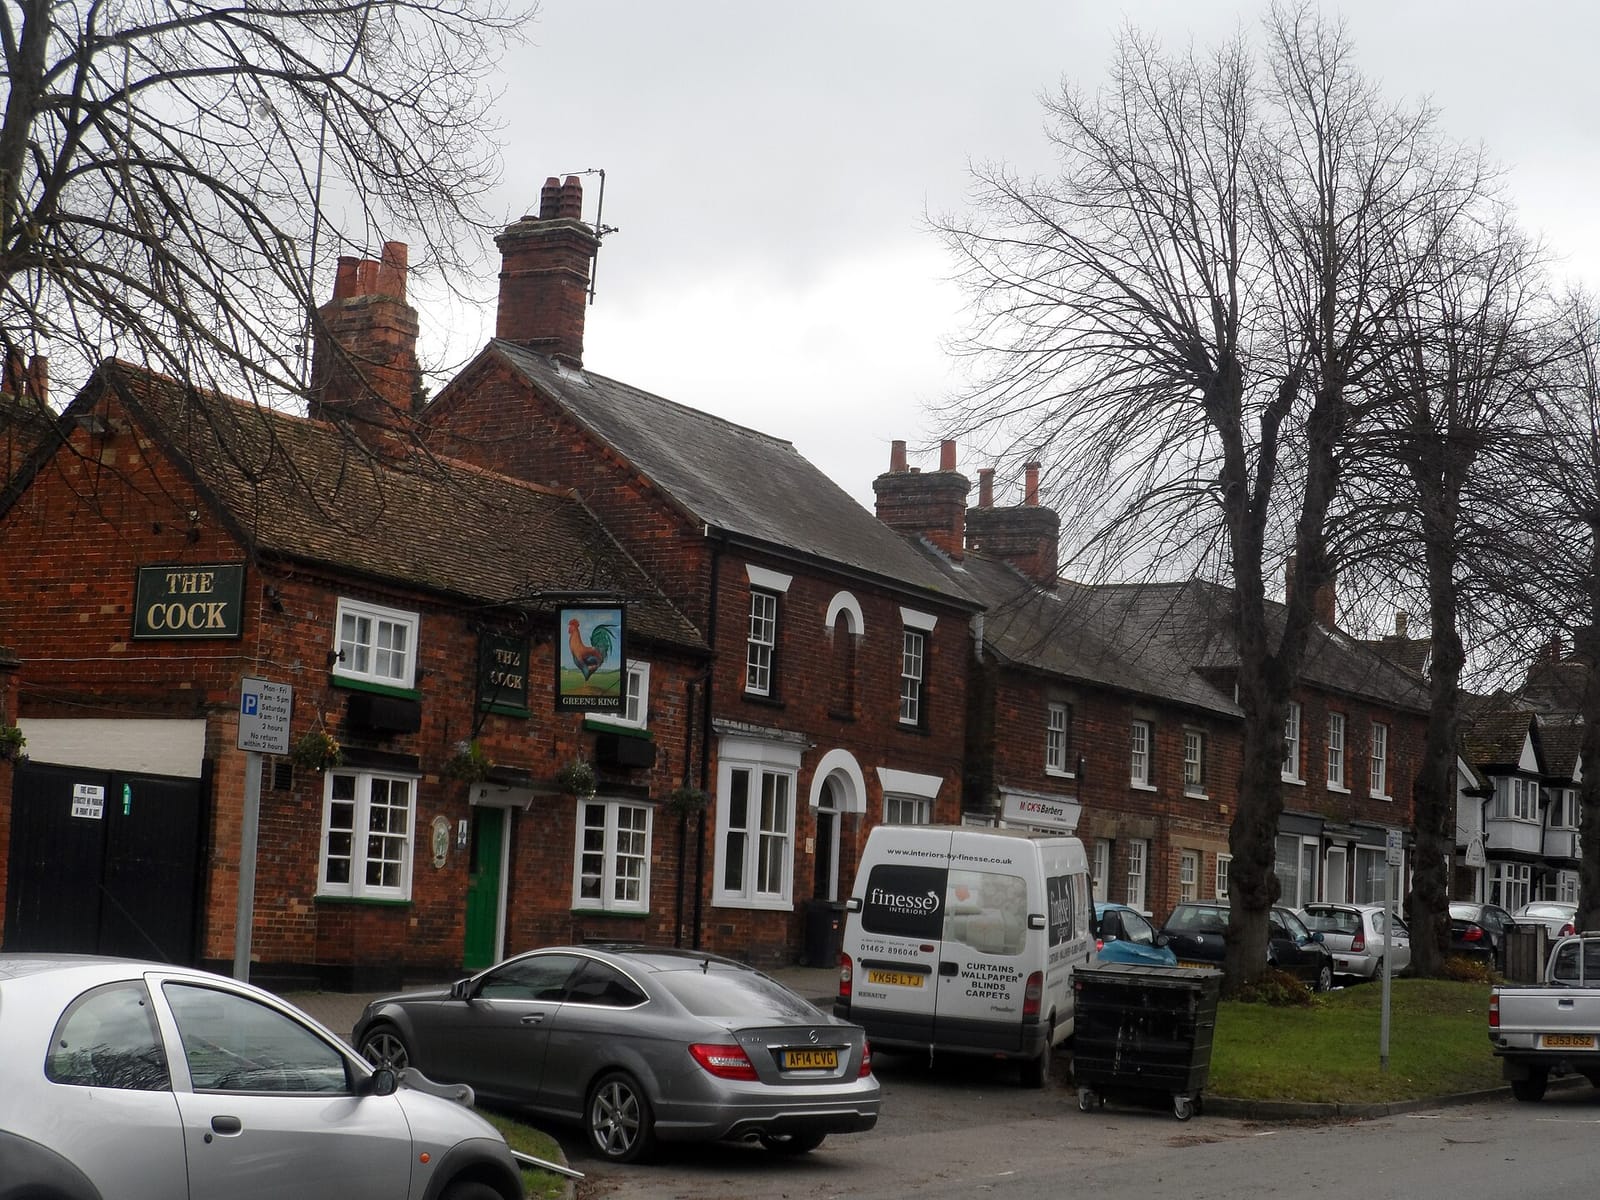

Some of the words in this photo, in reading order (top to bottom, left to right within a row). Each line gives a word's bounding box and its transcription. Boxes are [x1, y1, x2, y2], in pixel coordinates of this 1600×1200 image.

[166, 572, 214, 594] THE
[147, 602, 227, 629] COCK
[264, 684, 275, 693] Mon
[279, 686, 287, 694] Fri
[245, 695, 256, 713] P
[562, 697, 597, 706] GREENE
[598, 697, 619, 706] KING
[262, 704, 286, 714] Saturday
[267, 724, 283, 732] hours
[250, 732, 259, 740] No
[260, 734, 278, 742] return
[267, 743, 284, 751] hours
[1041, 804, 1064, 816] Barbers
[887, 848, 1013, 865] www.interiors-by-finesse.co.uk
[870, 888, 936, 911] finesse
[889, 907, 927, 916] INTERIORS
[860, 944, 885, 953] 01462
[887, 947, 919, 957] 896046
[966, 963, 1014, 974] CURTAINS
[872, 972, 898, 984] YK56
[900, 975, 920, 986] LTJ
[961, 971, 1018, 983] WALLPAPER
[971, 981, 1006, 991] BLINDS
[858, 991, 887, 1000] RENAULT
[965, 989, 1011, 1000] CARPETS
[790, 1051, 812, 1065] AF14
[814, 1051, 834, 1065] CVG
